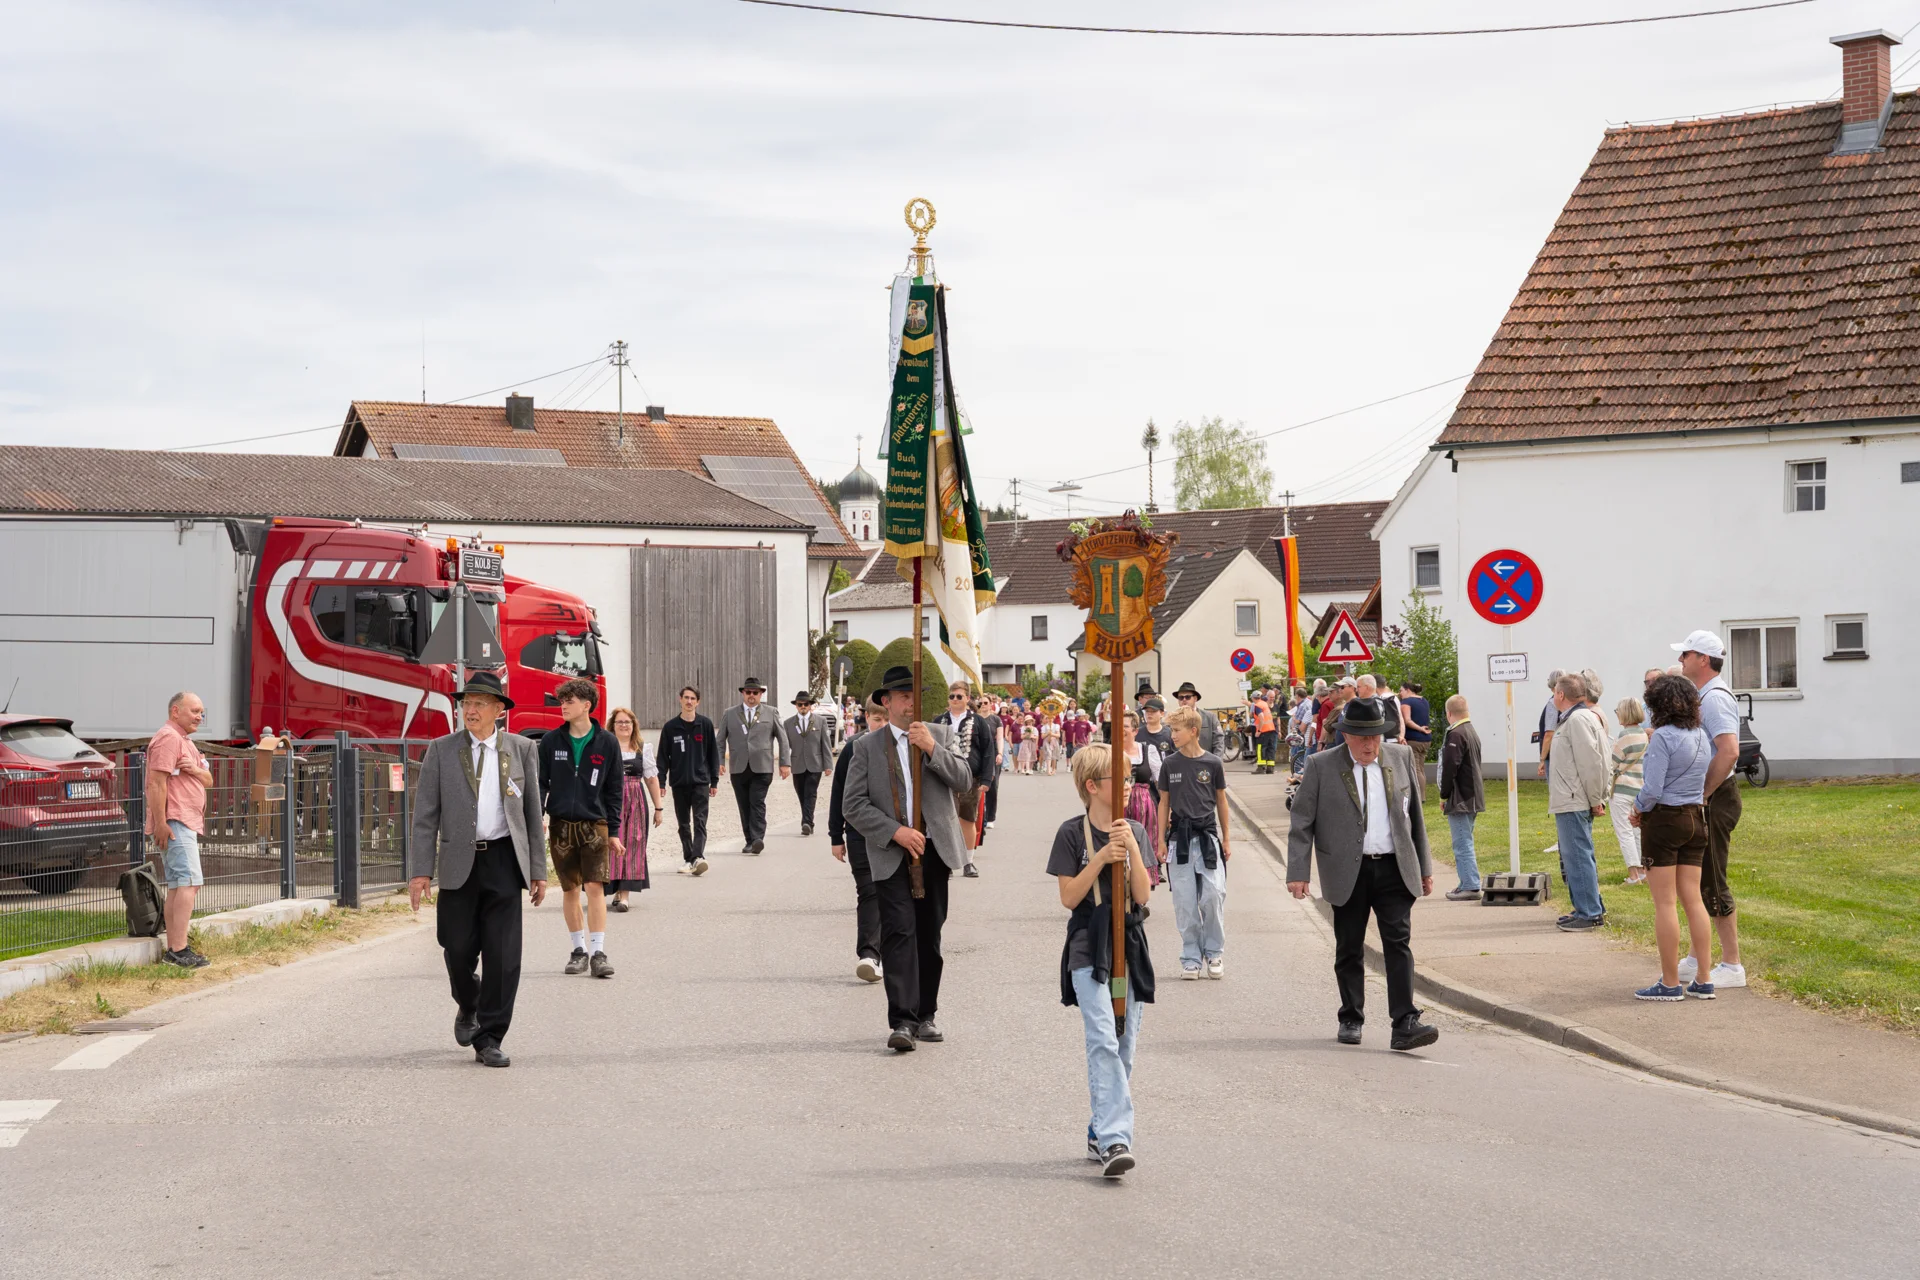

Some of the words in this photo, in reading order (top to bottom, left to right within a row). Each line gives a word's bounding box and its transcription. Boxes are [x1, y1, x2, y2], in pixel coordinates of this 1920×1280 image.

[906, 373, 920, 383] dem
[891, 392, 929, 444] Patenverein
[897, 451, 916, 464] Buch
[474, 556, 491, 570] KOLB
[955, 576, 974, 591] 20
[1093, 631, 1148, 659] BUCH
